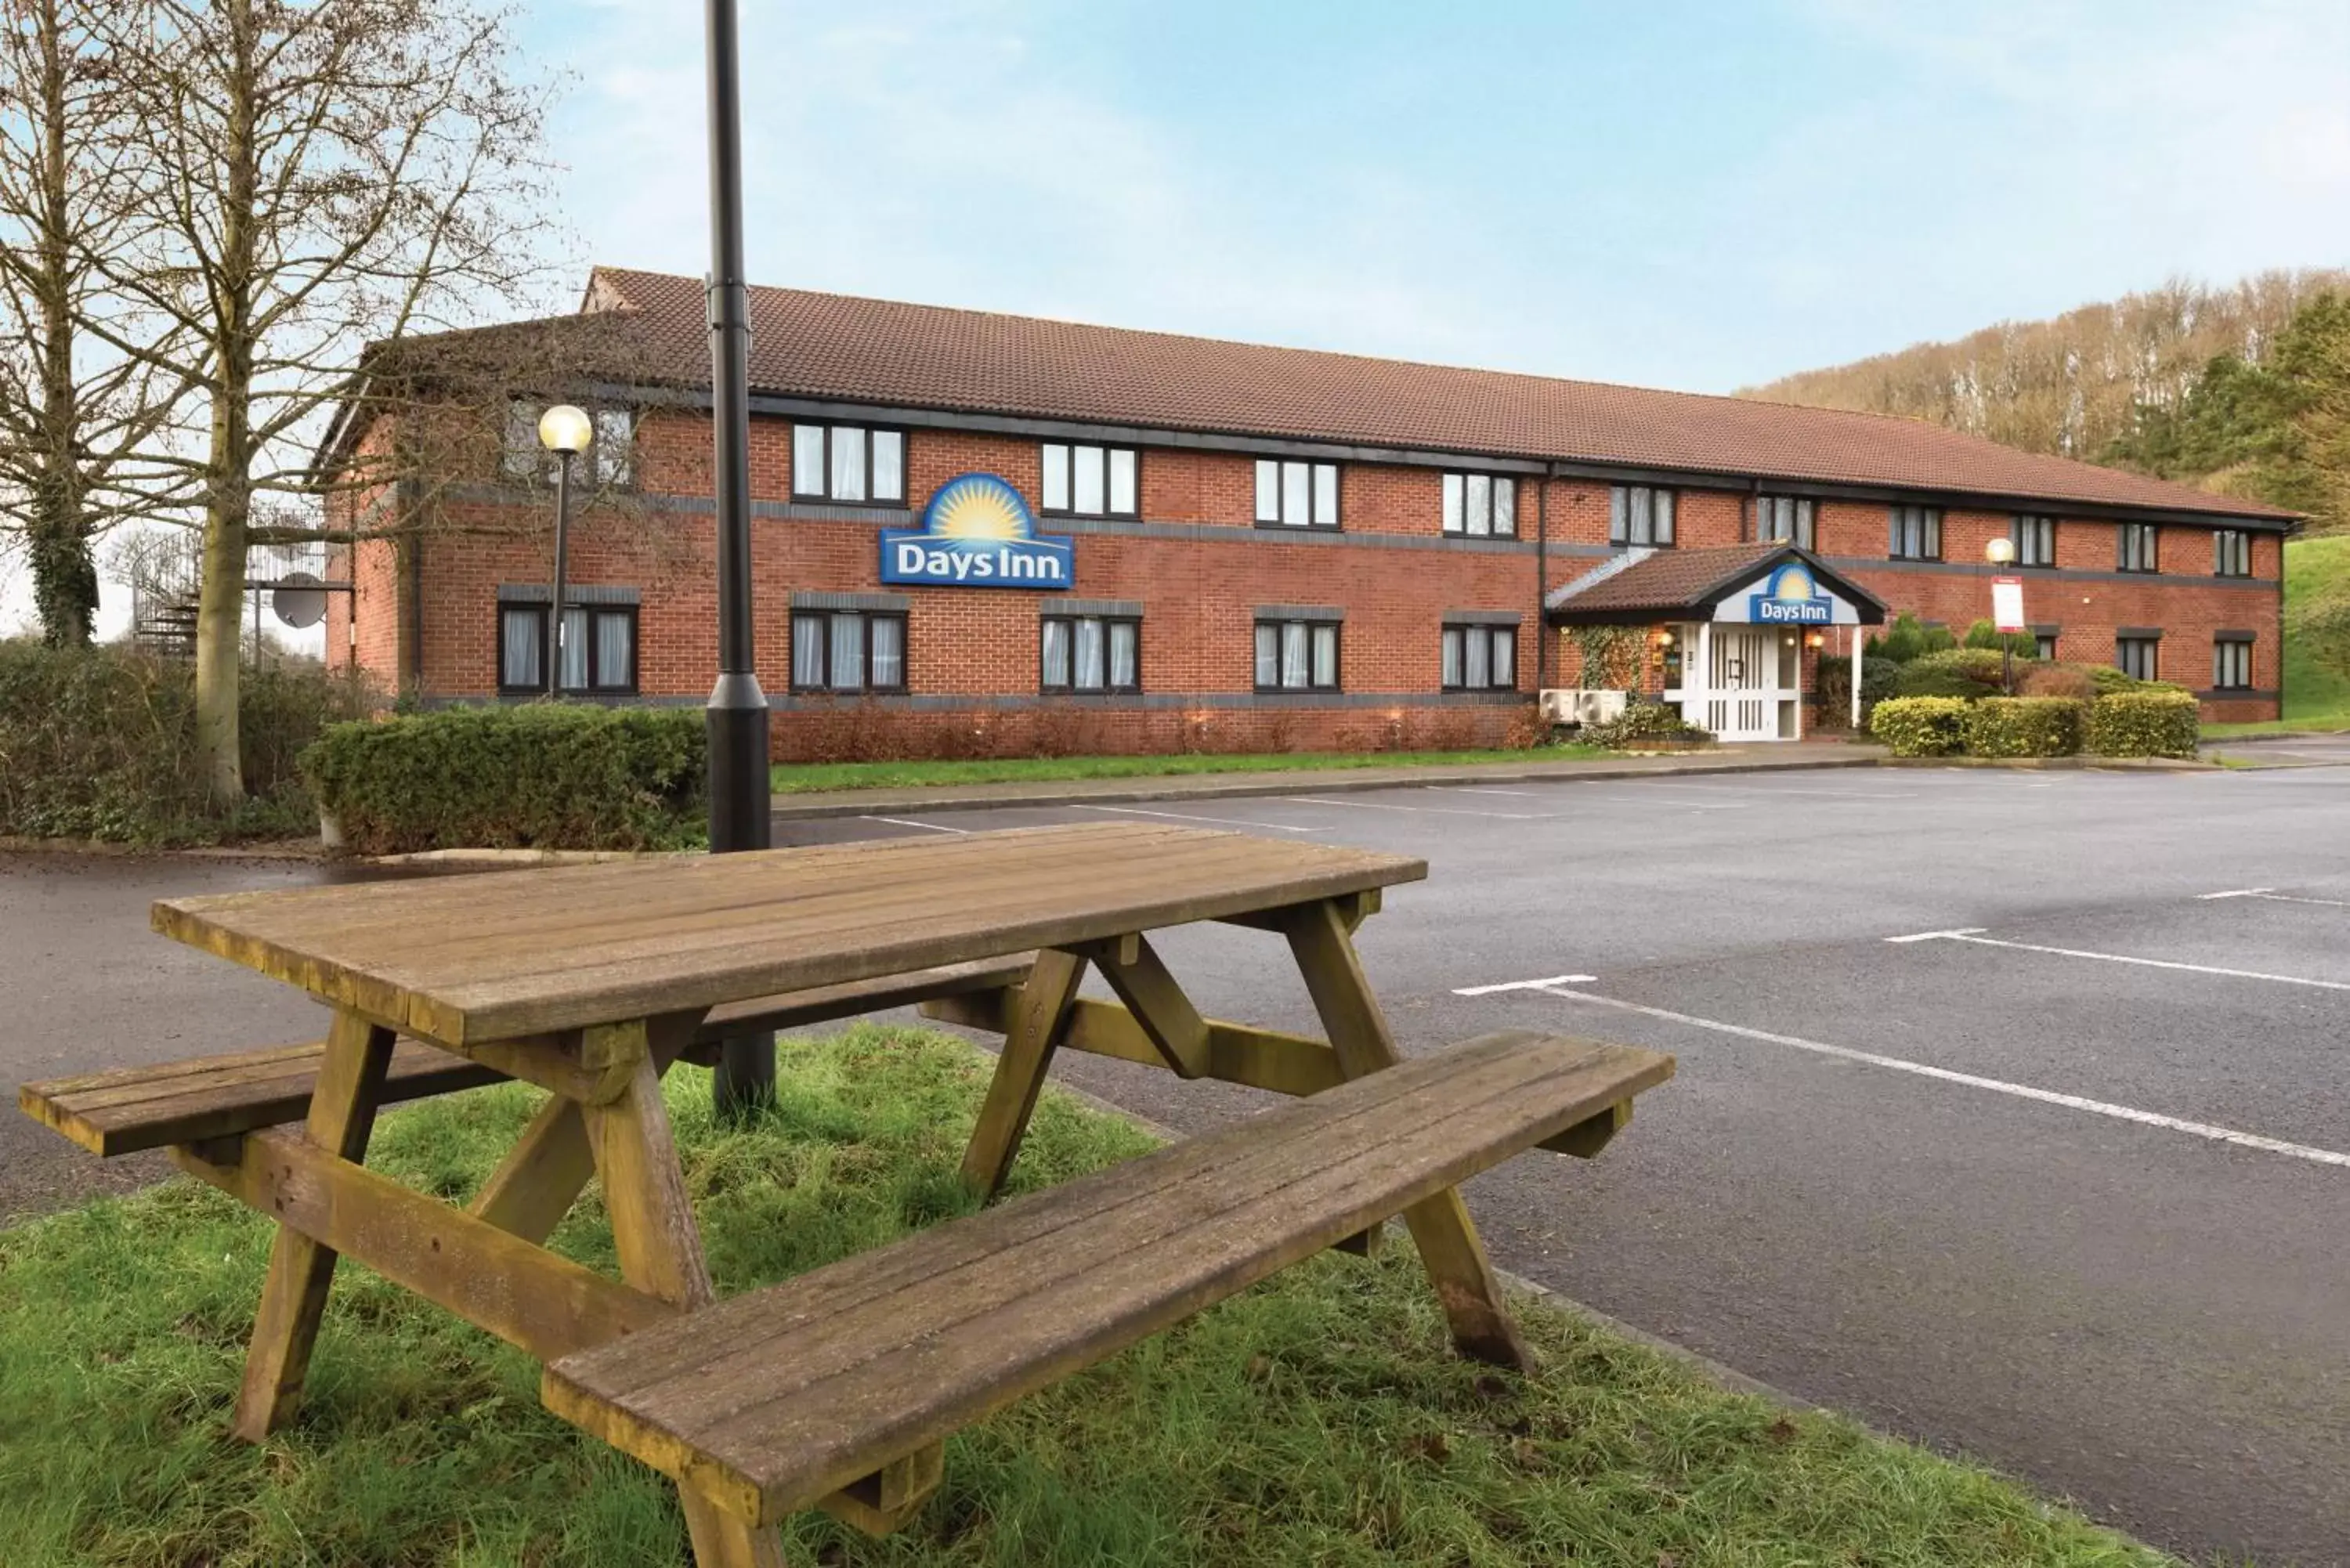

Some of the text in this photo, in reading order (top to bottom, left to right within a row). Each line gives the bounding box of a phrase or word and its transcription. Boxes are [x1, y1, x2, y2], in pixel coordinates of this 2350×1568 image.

[898, 544, 1064, 580] Days Inn
[1762, 602, 1827, 620] Days Inn
